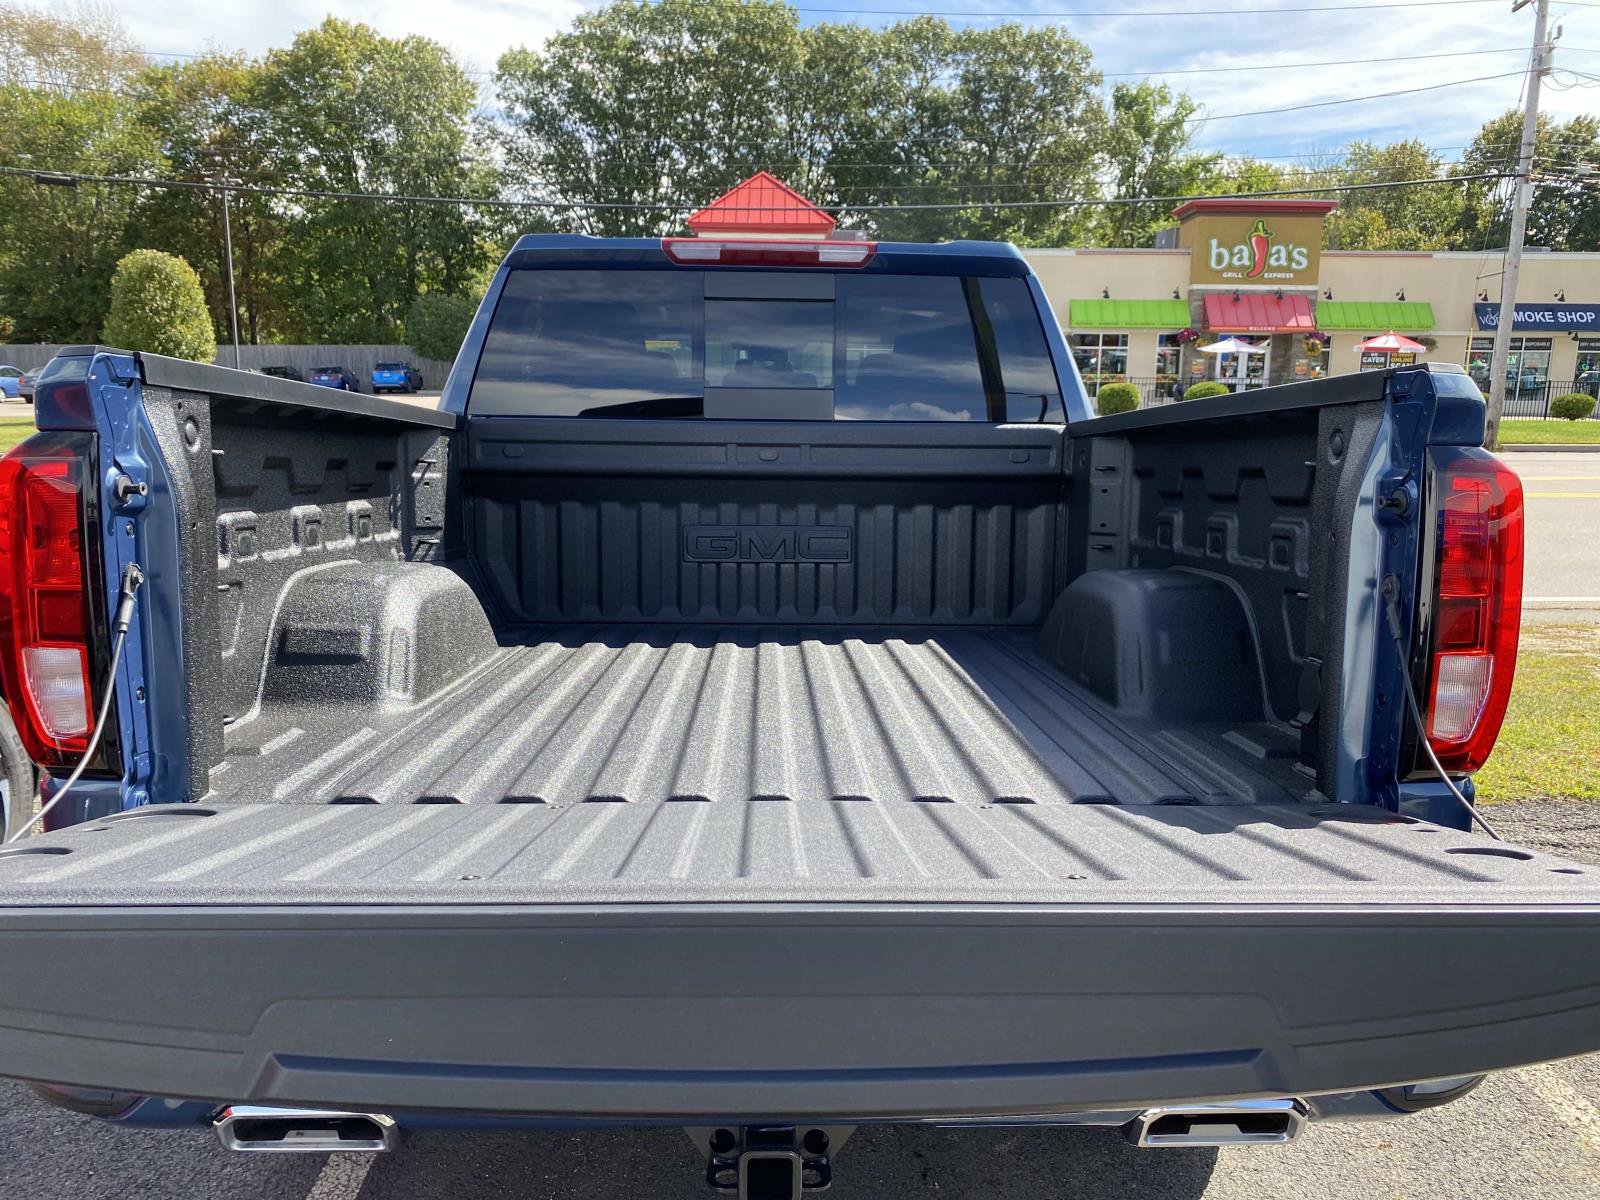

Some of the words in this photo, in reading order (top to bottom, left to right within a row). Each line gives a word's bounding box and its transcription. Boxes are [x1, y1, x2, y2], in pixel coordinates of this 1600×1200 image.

[1512, 311, 1555, 323] MOKE
[1557, 311, 1596, 323] SHOP
[682, 529, 849, 560] GMC
